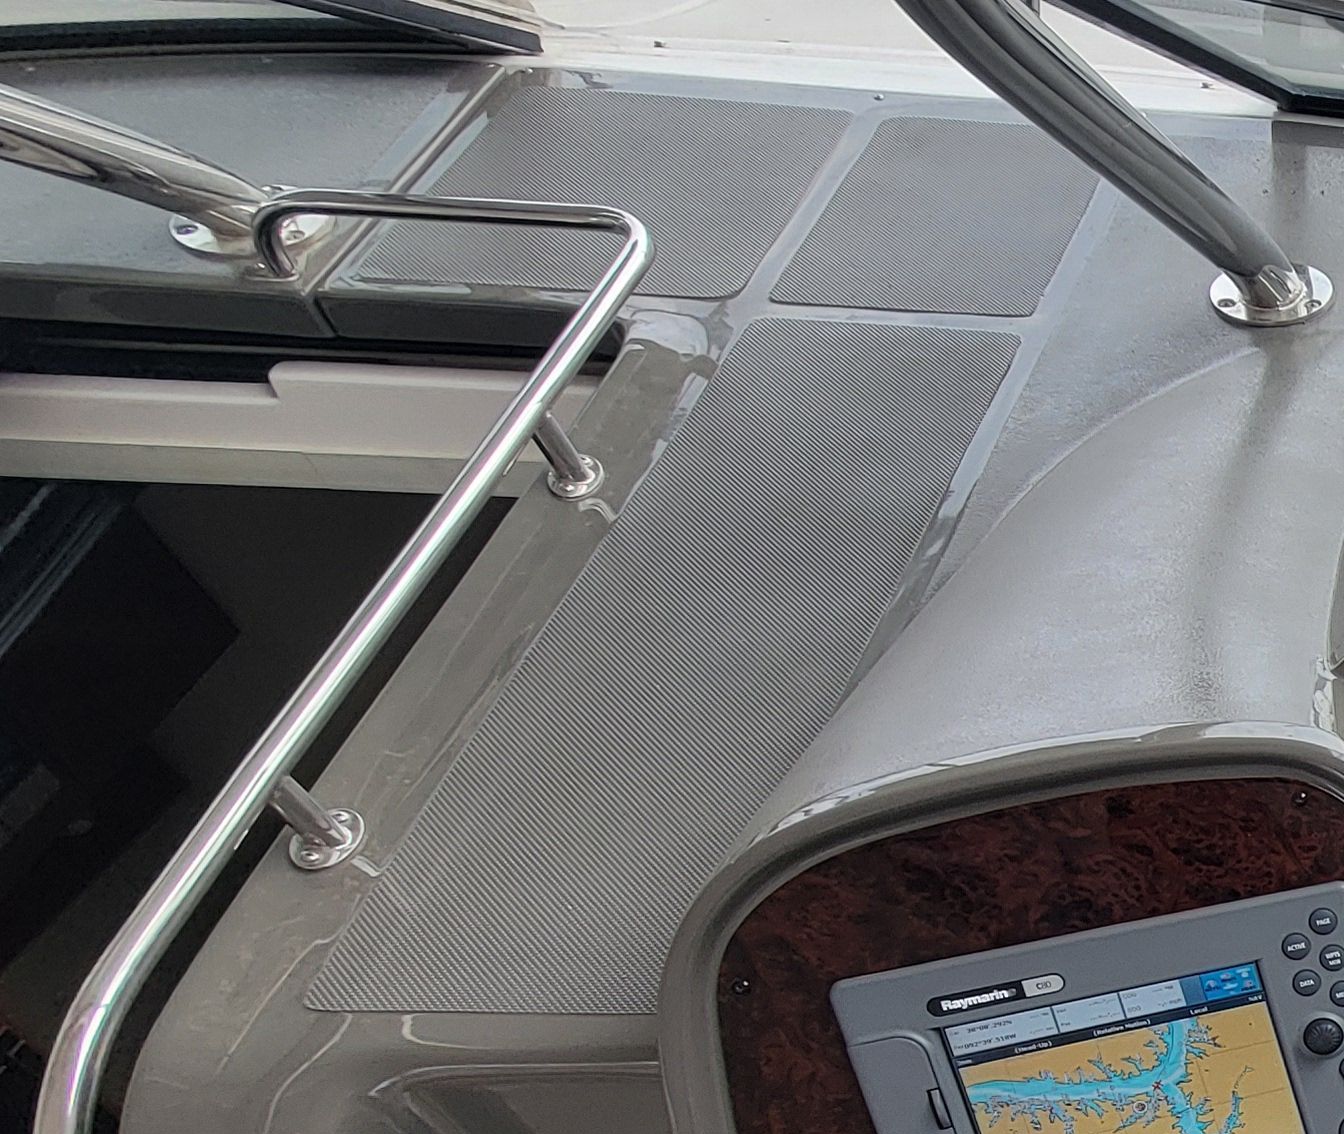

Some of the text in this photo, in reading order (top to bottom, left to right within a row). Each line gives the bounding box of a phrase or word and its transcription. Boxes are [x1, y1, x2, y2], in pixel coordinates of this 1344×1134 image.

[1315, 917, 1332, 926] PAGE
[1287, 942, 1306, 952] ACTIVE
[1299, 979, 1315, 988] DATA
[940, 988, 1017, 1012] Raymarine
